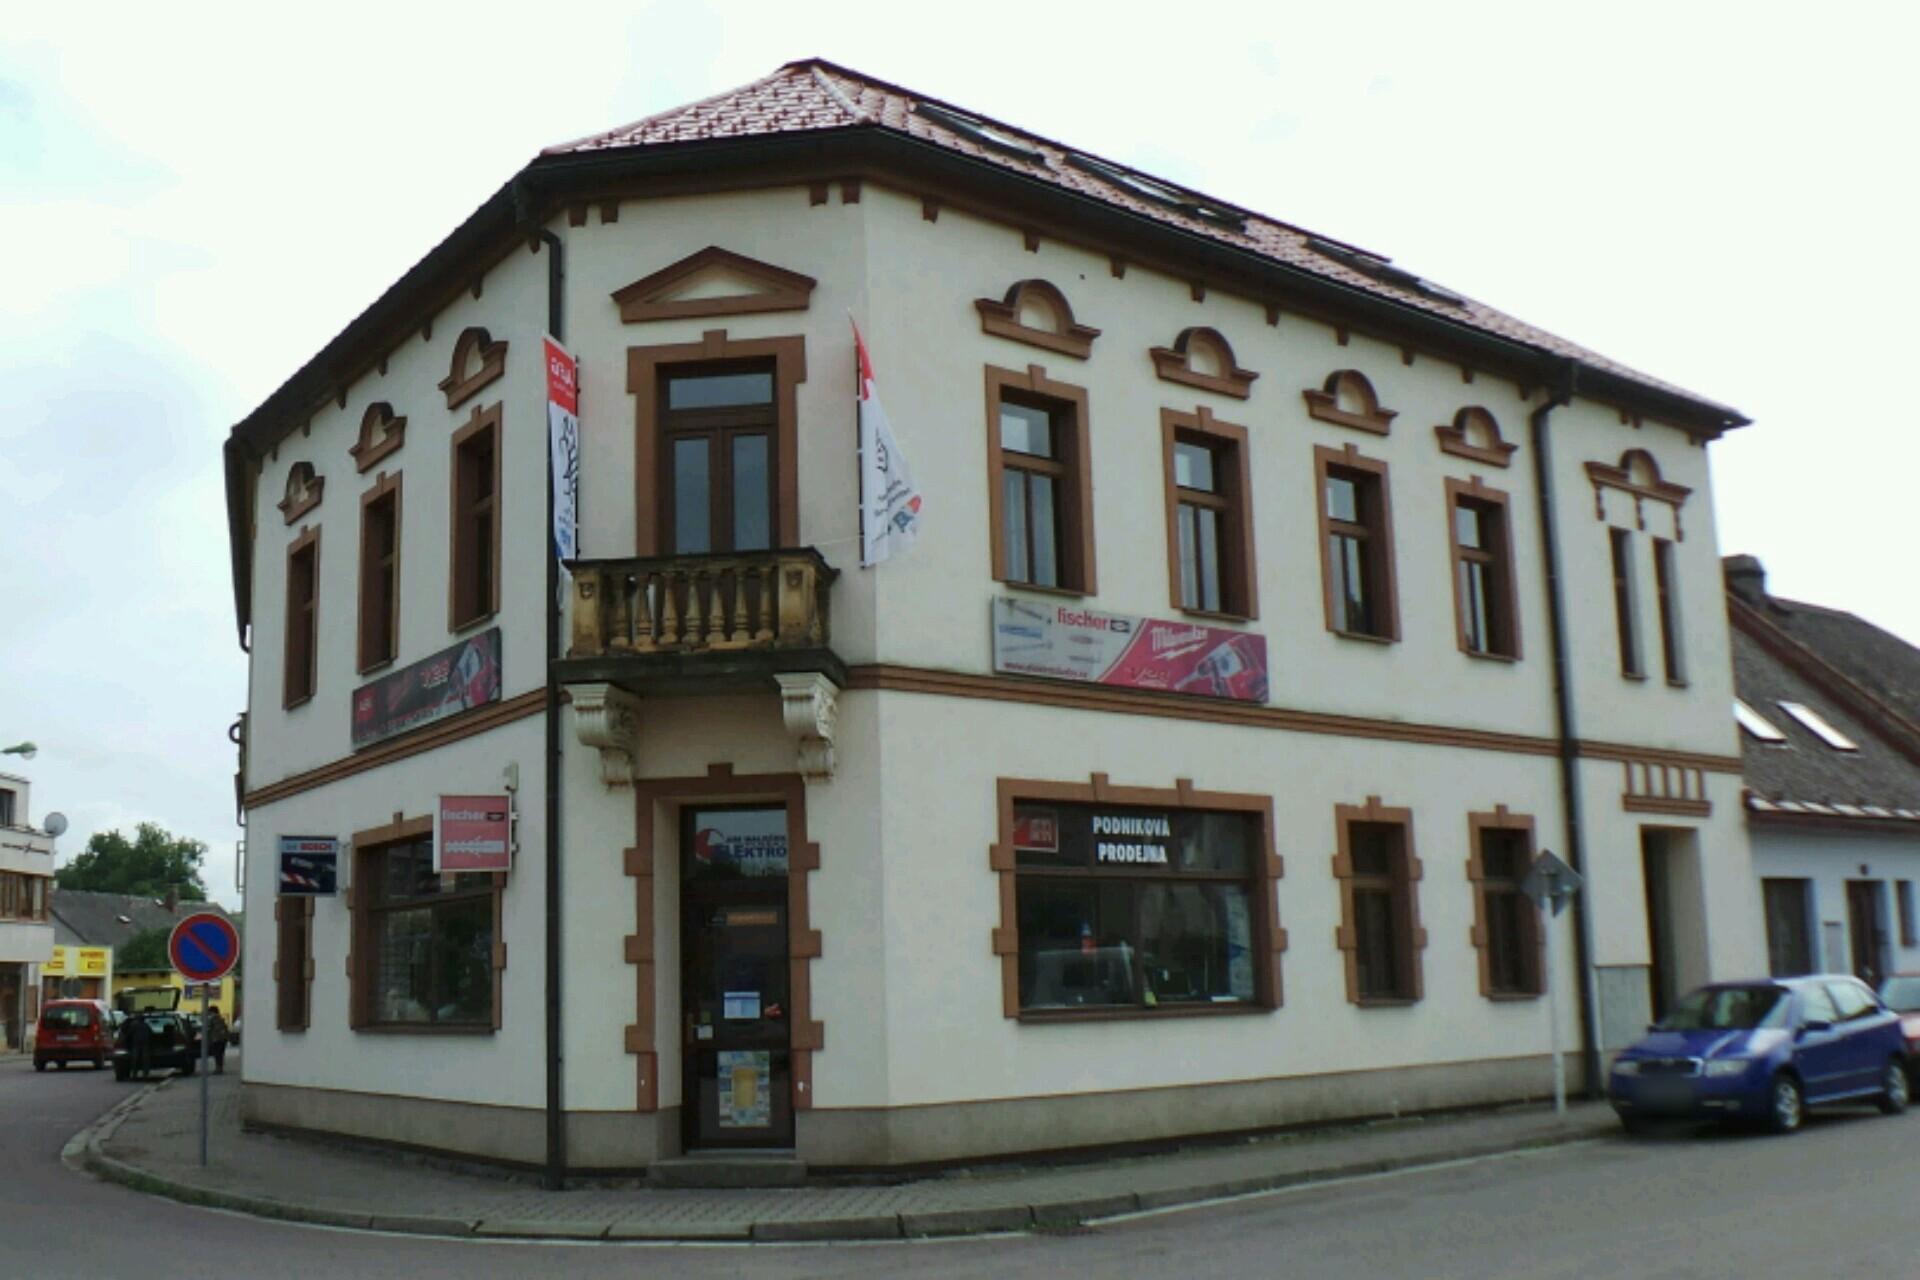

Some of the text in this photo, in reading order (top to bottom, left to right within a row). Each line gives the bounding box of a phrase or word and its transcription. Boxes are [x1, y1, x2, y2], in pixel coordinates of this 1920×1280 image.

[1057, 608, 1108, 631] fischer
[1093, 814, 1170, 837] PODNIKOVÁ
[1098, 842, 1168, 863] PRODEJNA
